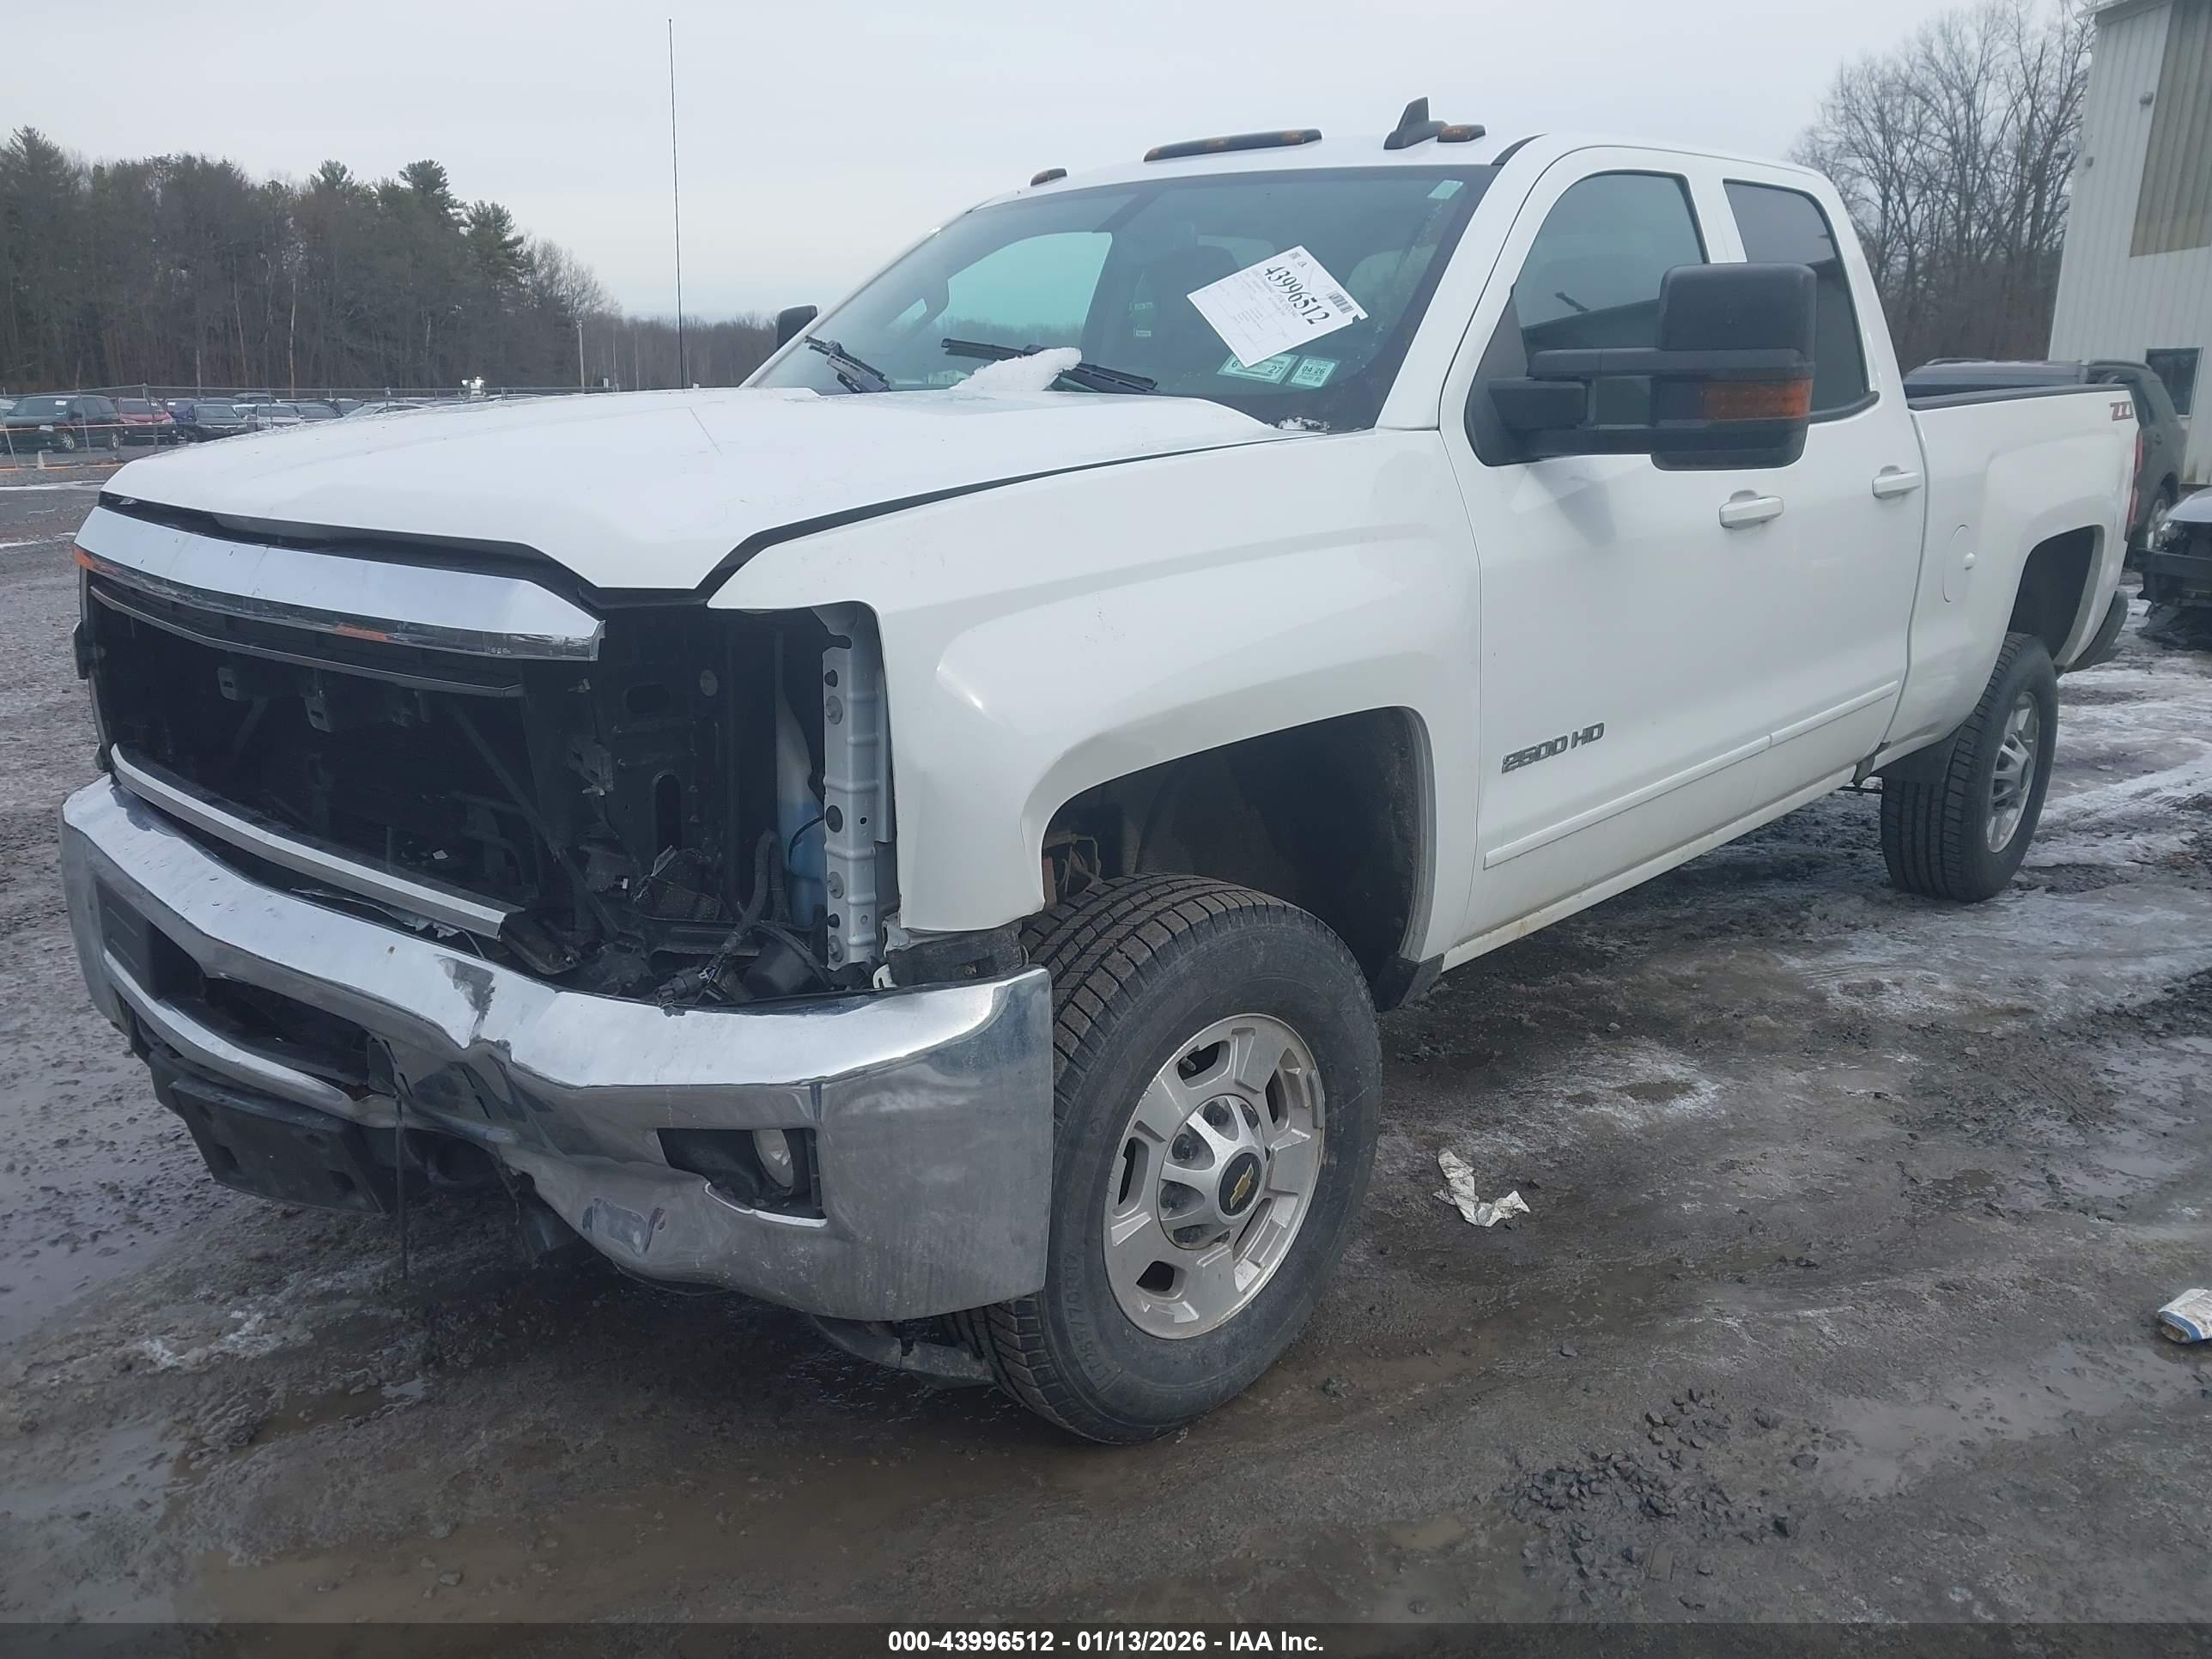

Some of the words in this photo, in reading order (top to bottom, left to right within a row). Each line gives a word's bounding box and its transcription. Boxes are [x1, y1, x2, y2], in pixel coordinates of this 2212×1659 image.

[1265, 265, 1330, 325] 43996512
[1502, 735, 1568, 774] 2500
[1571, 722, 1604, 749] HD
